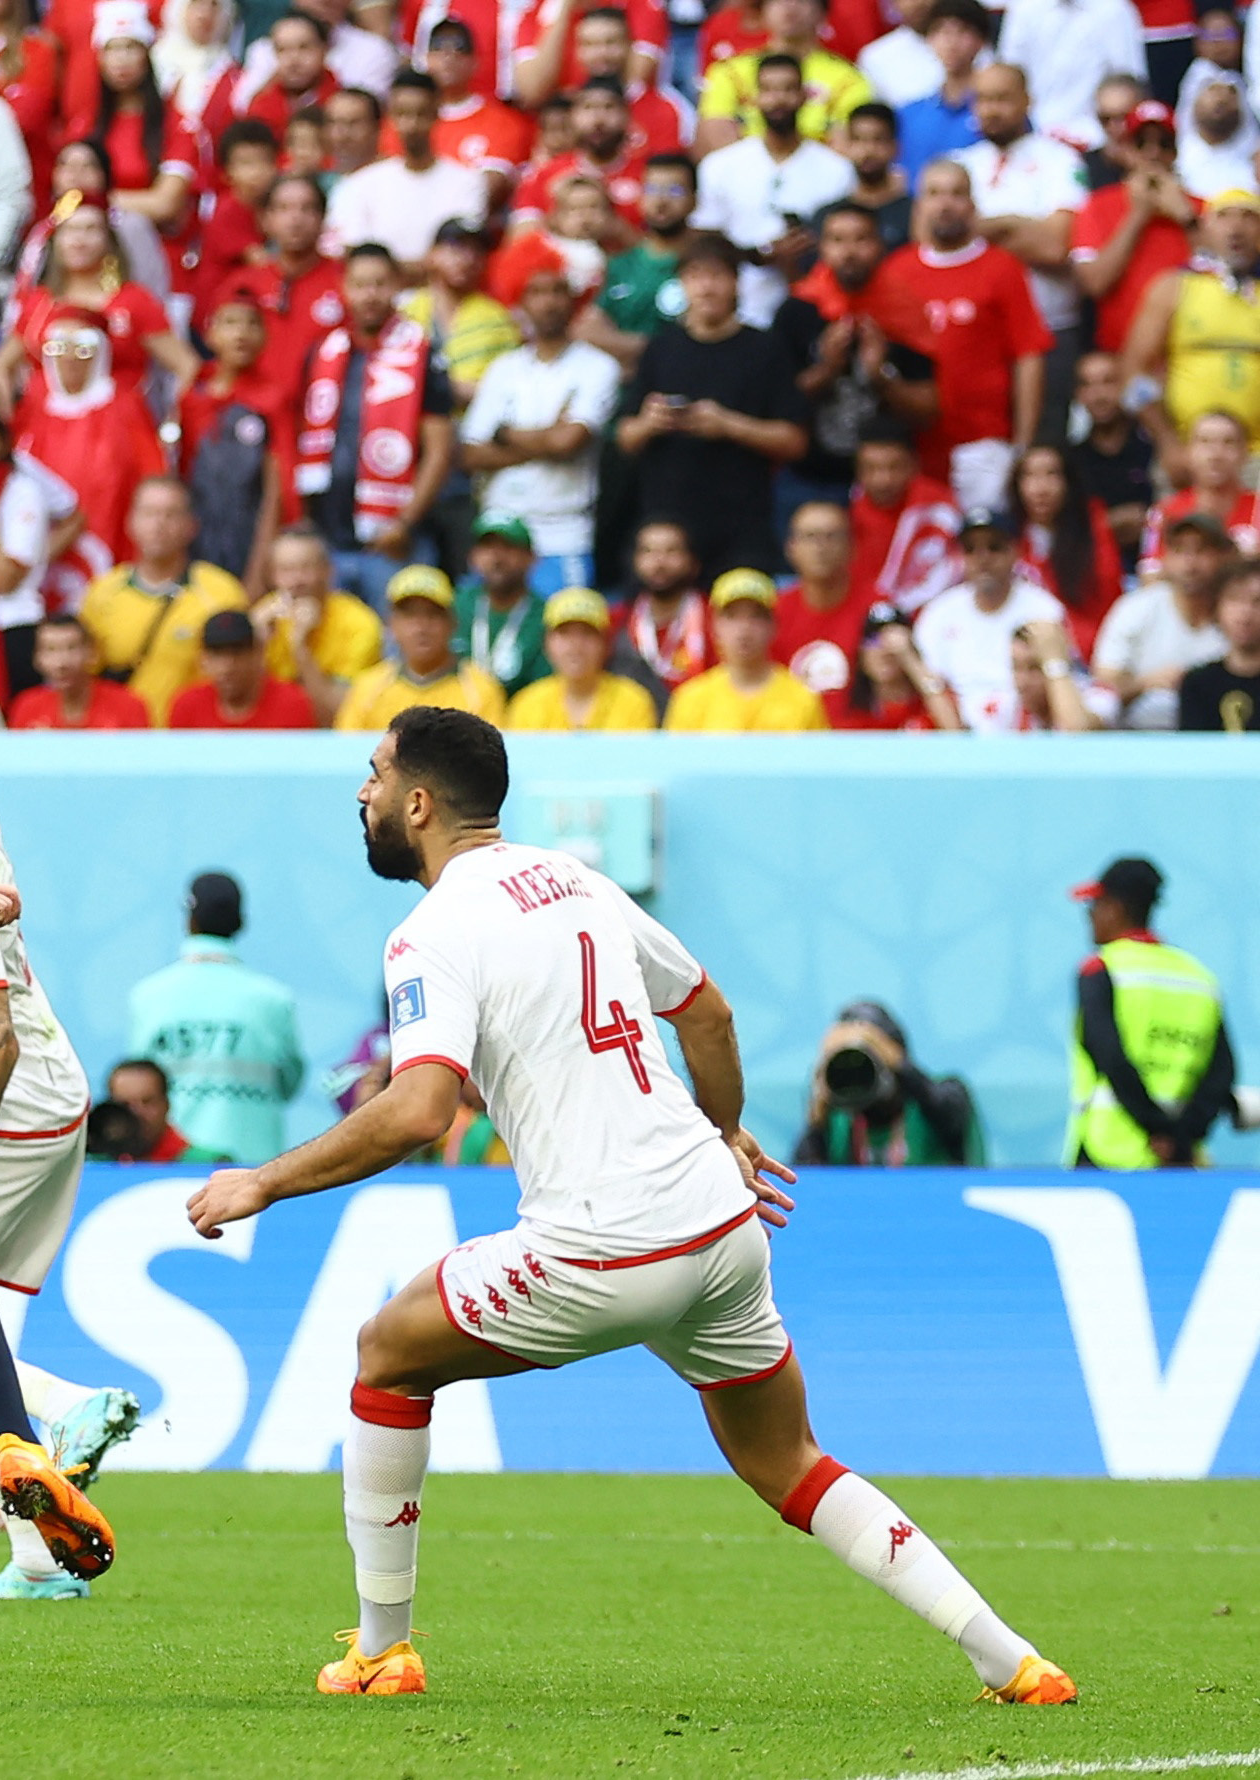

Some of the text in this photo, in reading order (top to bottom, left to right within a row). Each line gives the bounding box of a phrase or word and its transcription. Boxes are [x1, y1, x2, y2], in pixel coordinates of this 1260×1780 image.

[498, 860, 593, 914] MER
[577, 931, 652, 1094] 4
[961, 1185, 1260, 1481] V
